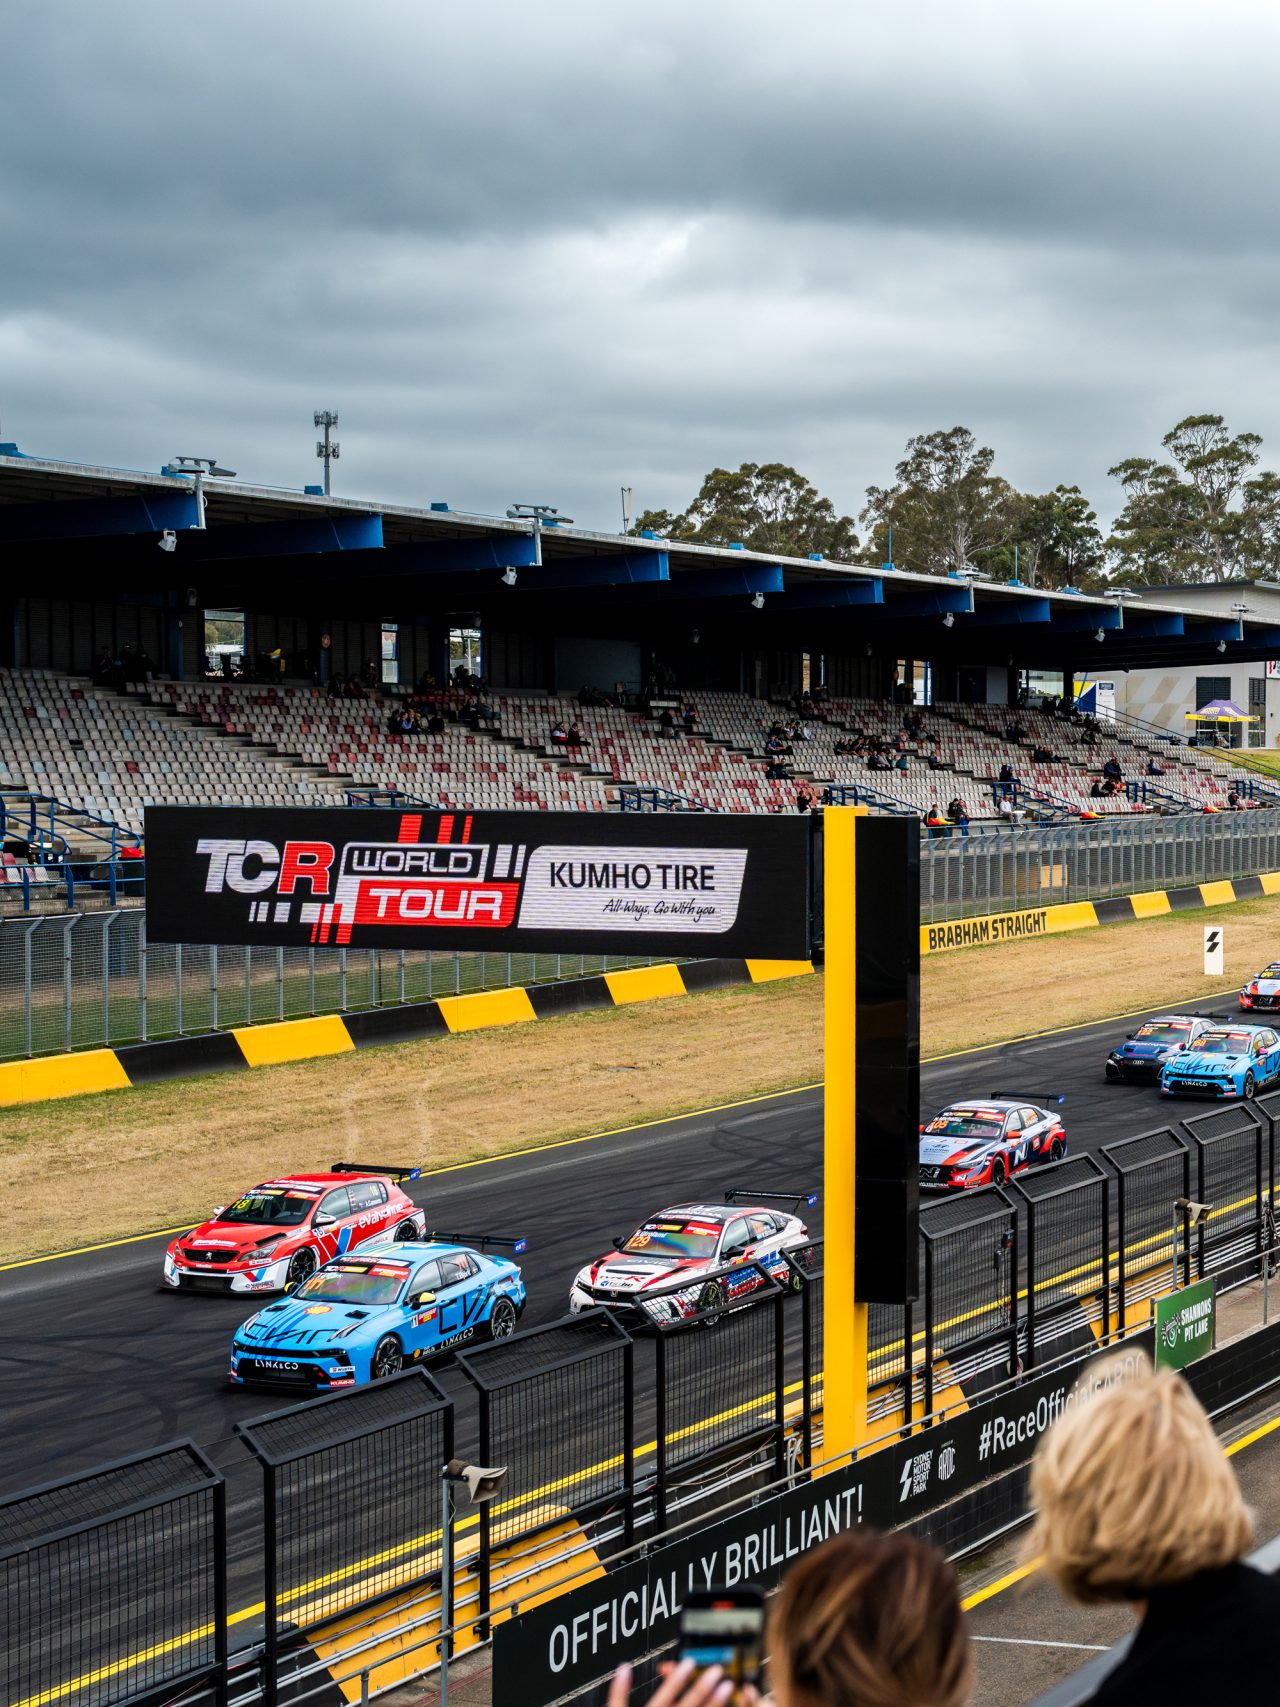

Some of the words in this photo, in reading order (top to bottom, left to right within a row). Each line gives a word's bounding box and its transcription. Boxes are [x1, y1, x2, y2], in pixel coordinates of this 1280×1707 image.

[196, 839, 335, 895] TCR
[352, 850, 474, 873] WORLD
[550, 861, 652, 890] KUMHO
[656, 864, 716, 891] TIRE
[369, 888, 503, 920] TOUR
[653, 900, 670, 916] Go
[694, 904, 717, 924] you
[929, 921, 990, 951] BRABHAM
[992, 912, 1048, 940] STRAIGHT
[232, 1199, 252, 1209] 18
[1180, 1298, 1211, 1326] SHANNONS
[1184, 1325, 1195, 1343] PIT
[1194, 1318, 1209, 1338] LANE
[913, 1449, 933, 1466] SYDNEY
[913, 1460, 931, 1476] MOTOR
[938, 1447, 956, 1481] ARDC
[913, 1470, 929, 1486] SPORT
[913, 1480, 927, 1495] PARK
[725, 1484, 864, 1588] BRILLIANT!
